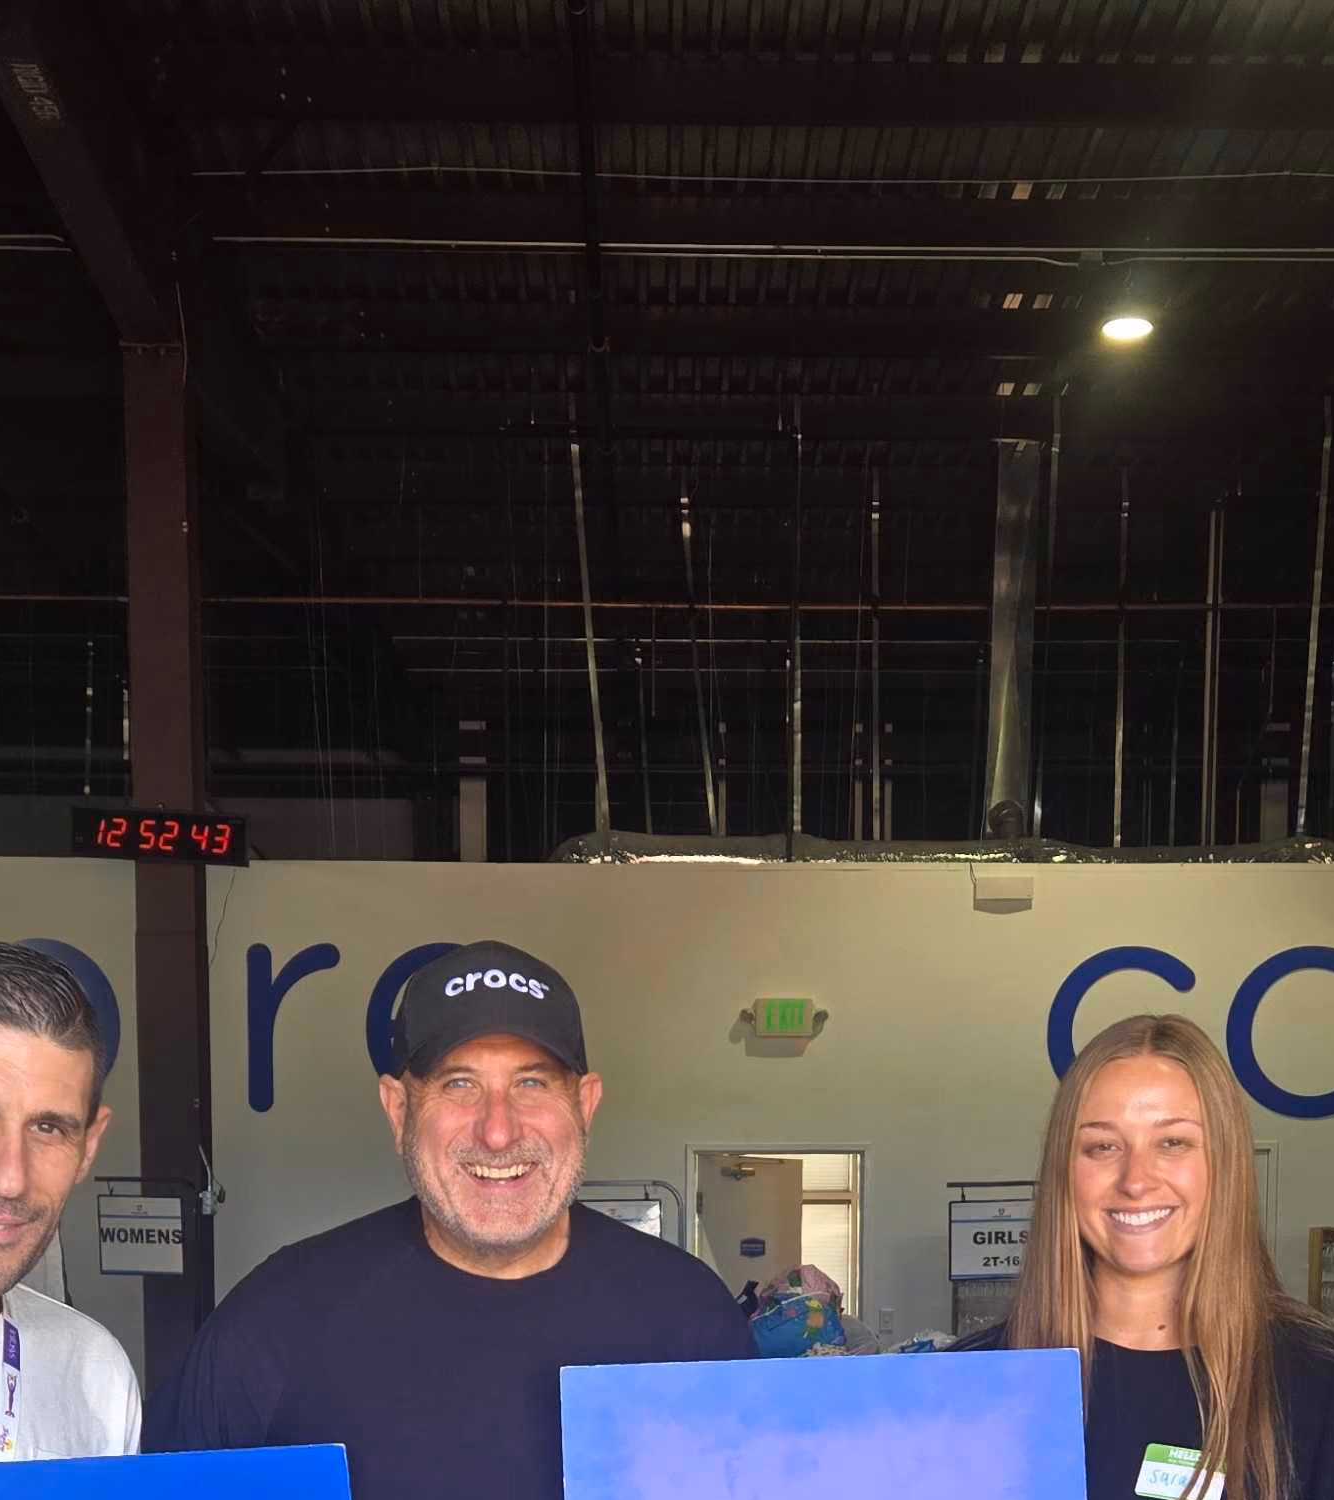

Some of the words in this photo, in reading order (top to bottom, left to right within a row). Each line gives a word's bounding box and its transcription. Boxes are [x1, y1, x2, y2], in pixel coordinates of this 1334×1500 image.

[97, 817, 128, 848] 12
[138, 819, 179, 851] 52
[191, 824, 231, 854] 43
[444, 968, 546, 1000] crocs
[765, 1000, 805, 1032] EXIT
[100, 1227, 183, 1244] WOMENS
[972, 1230, 1029, 1245] GIRLS
